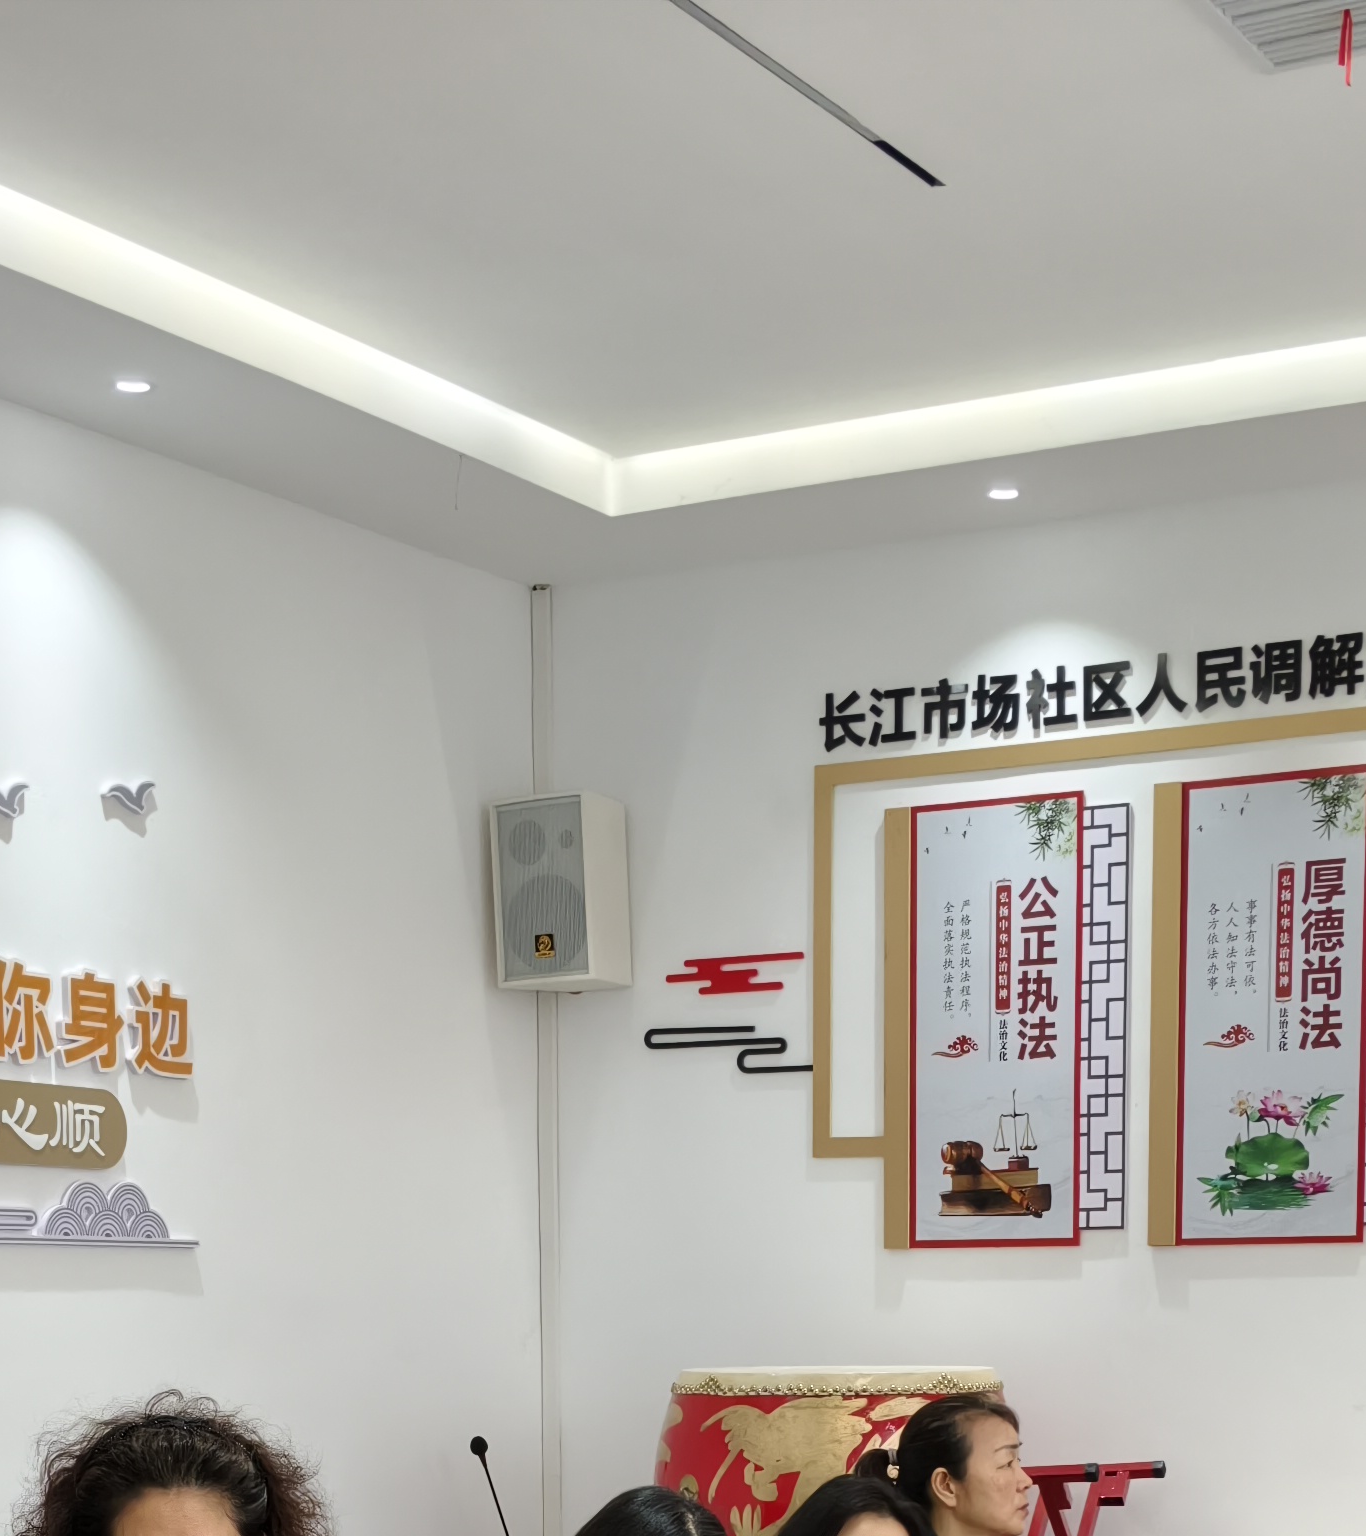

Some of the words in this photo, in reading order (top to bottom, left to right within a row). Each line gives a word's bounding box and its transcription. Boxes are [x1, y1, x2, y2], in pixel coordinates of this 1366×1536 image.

[998, 891, 1009, 1000] 弘扬中华法治精神
[1017, 876, 1059, 1060] 公正执法
[1278, 874, 1291, 988] 弘扬中华法治精神
[1299, 857, 1346, 1050] 厚德尚法
[998, 1018, 1009, 1062] 法治文化
[1278, 1007, 1289, 1052] 法治文化
